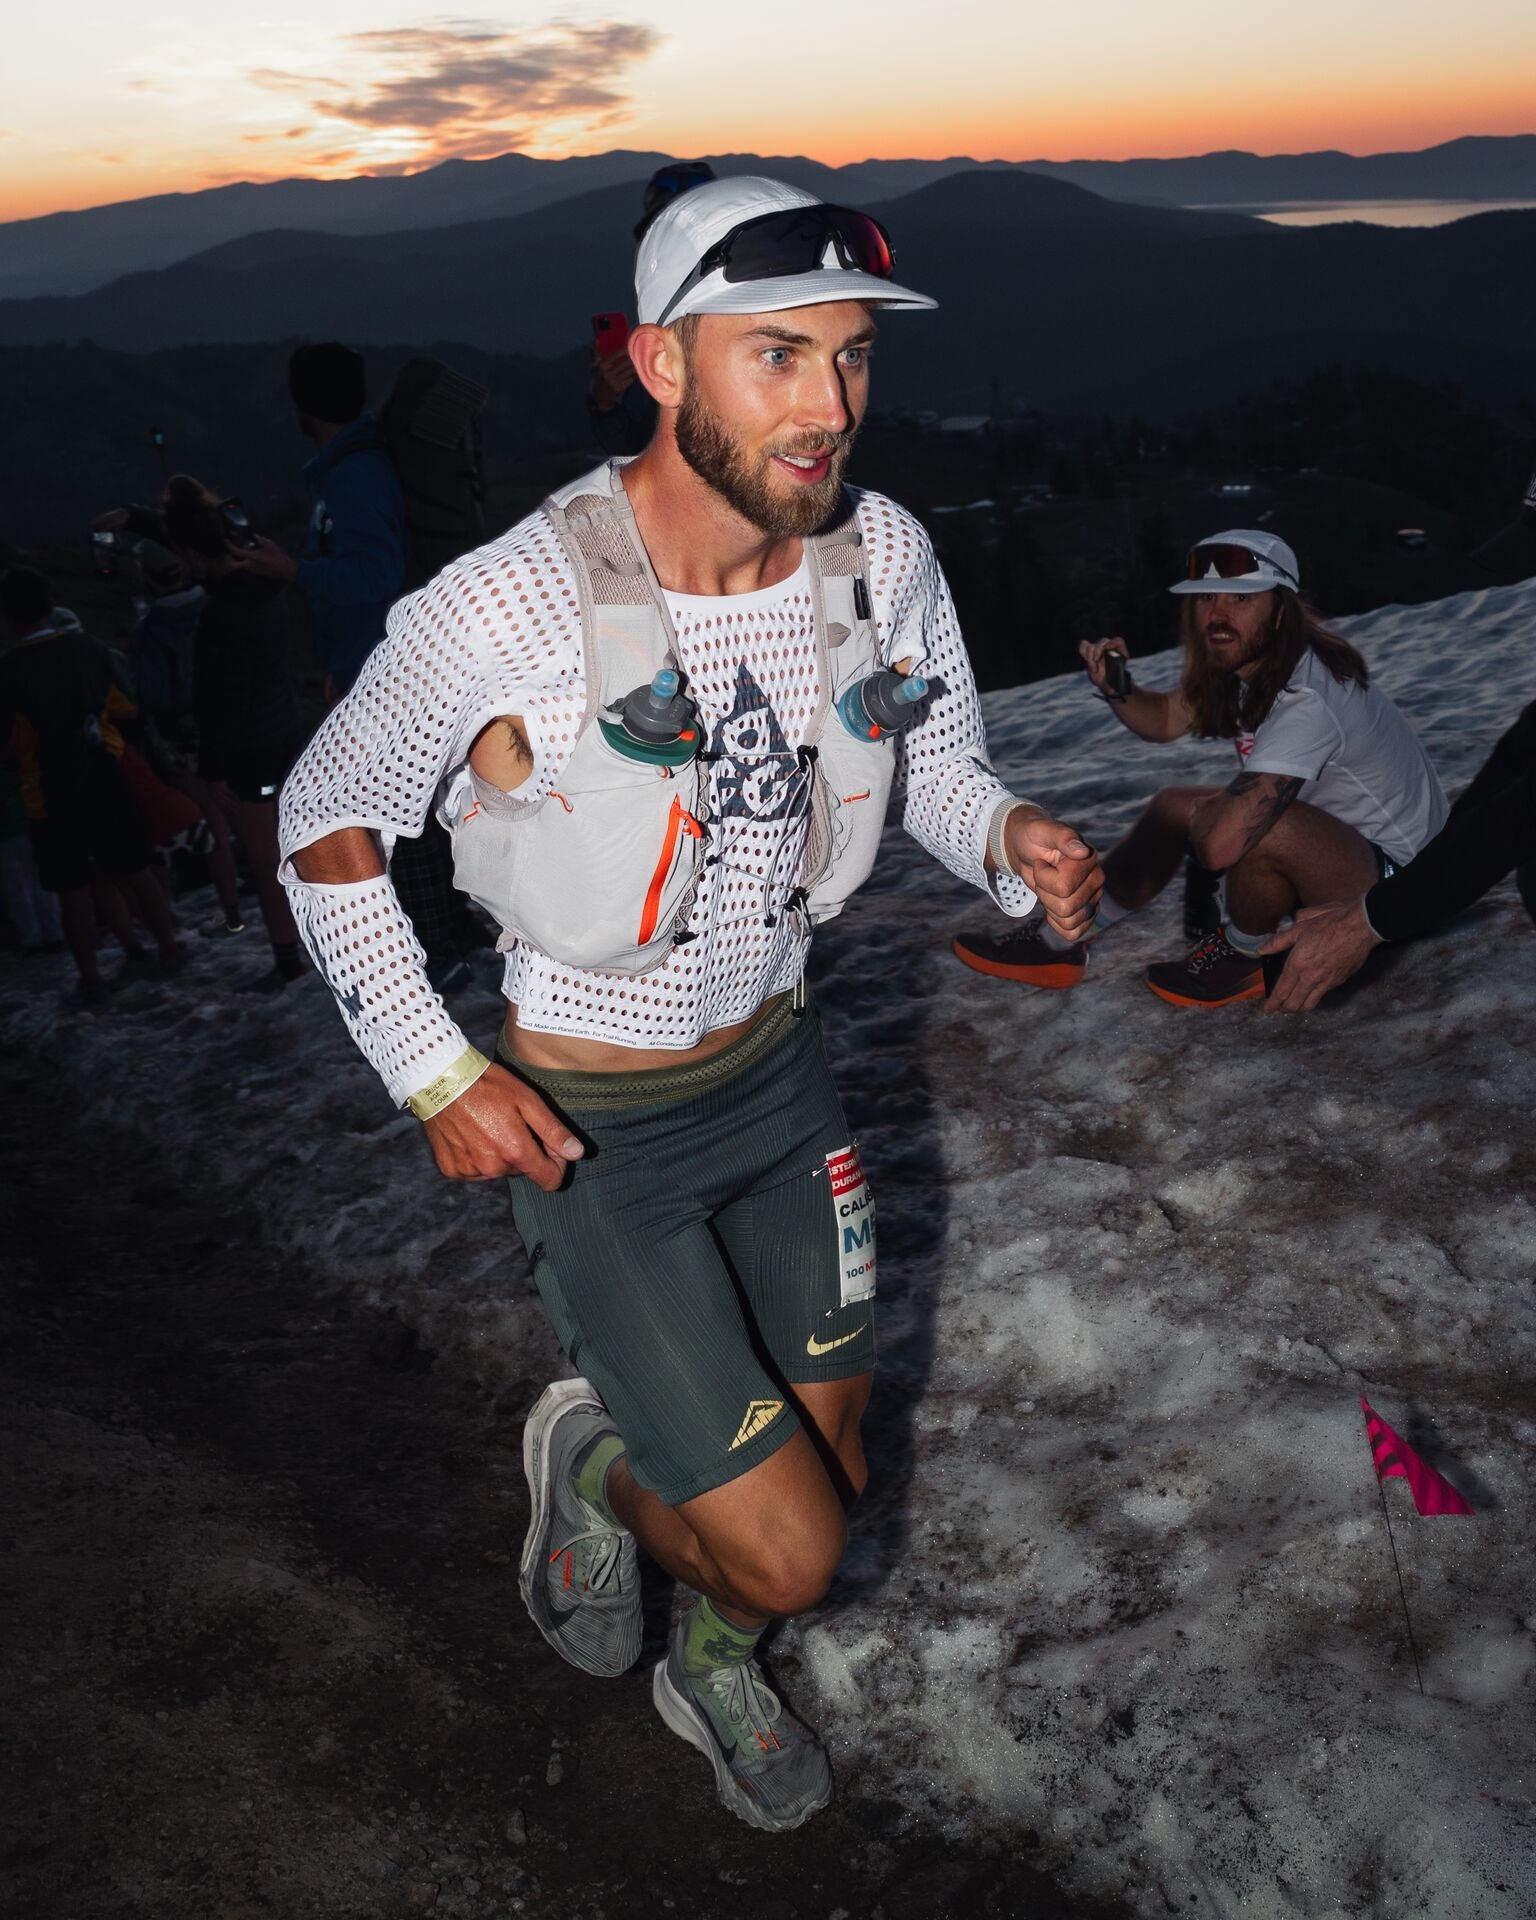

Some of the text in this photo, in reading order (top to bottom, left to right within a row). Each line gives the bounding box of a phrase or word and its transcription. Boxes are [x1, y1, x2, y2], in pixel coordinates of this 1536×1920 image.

[521, 1020, 533, 1028] and
[533, 1022, 550, 1030] Made
[557, 1026, 575, 1034] Planet
[655, 1040, 683, 1048] Conditions
[846, 1265, 865, 1279] 100
